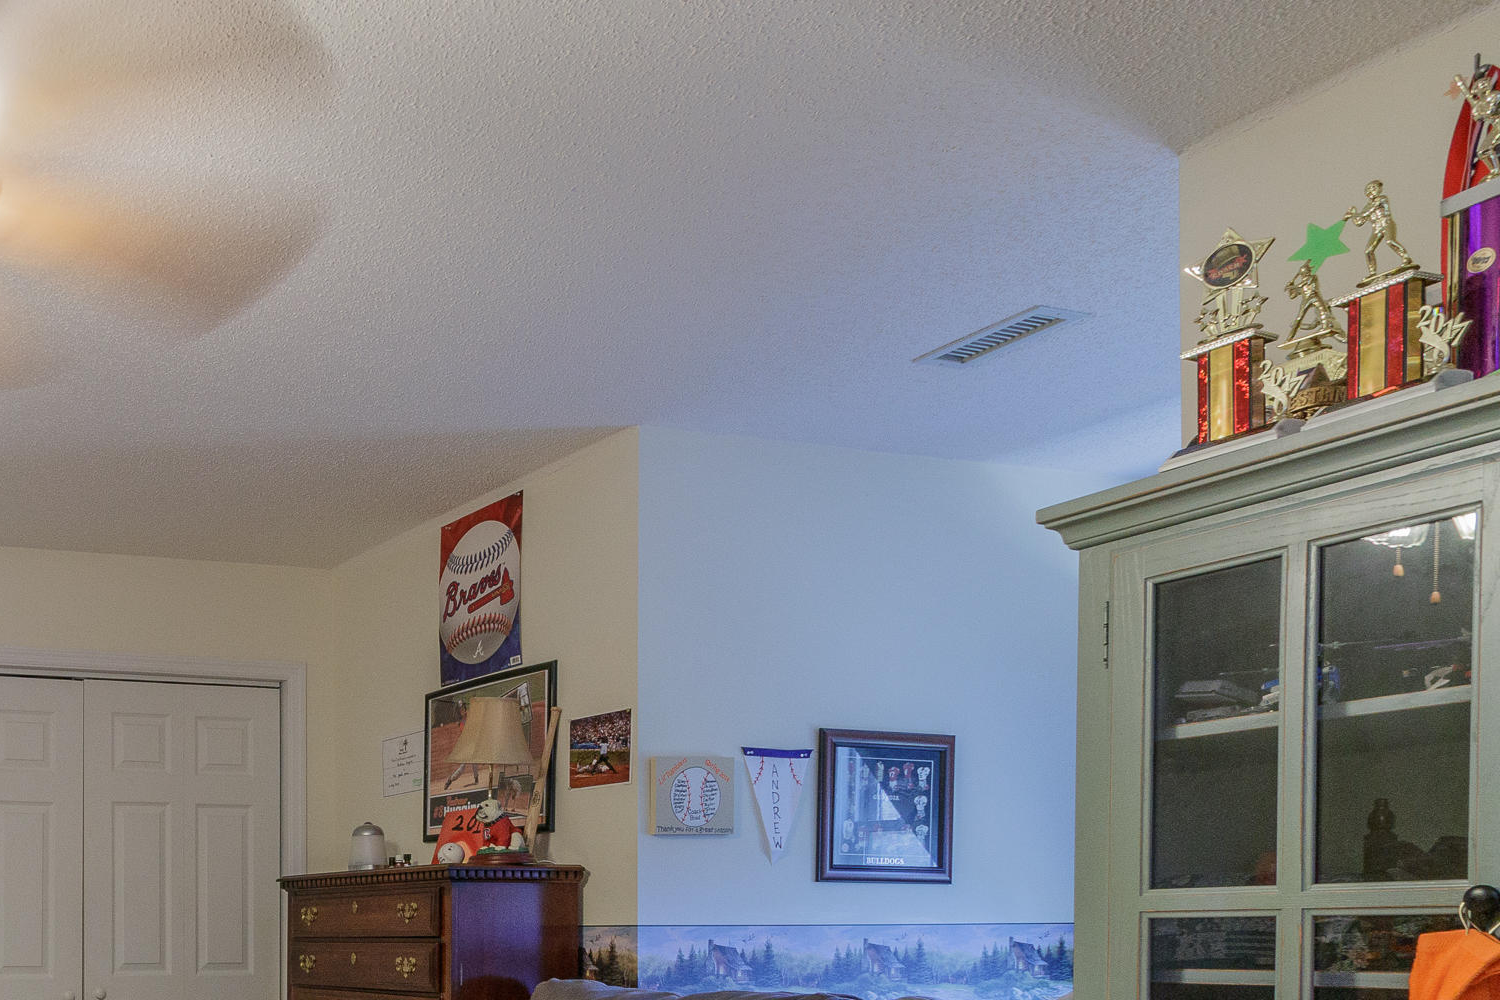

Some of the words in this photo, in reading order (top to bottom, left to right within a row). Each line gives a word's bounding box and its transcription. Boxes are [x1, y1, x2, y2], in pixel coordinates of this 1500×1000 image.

[1418, 304, 1473, 347] 2017
[1257, 360, 1306, 398] 2017
[443, 564, 502, 623] Braves
[771, 764, 782, 850] ANDREW
[866, 857, 905, 865] BULLDOGS
